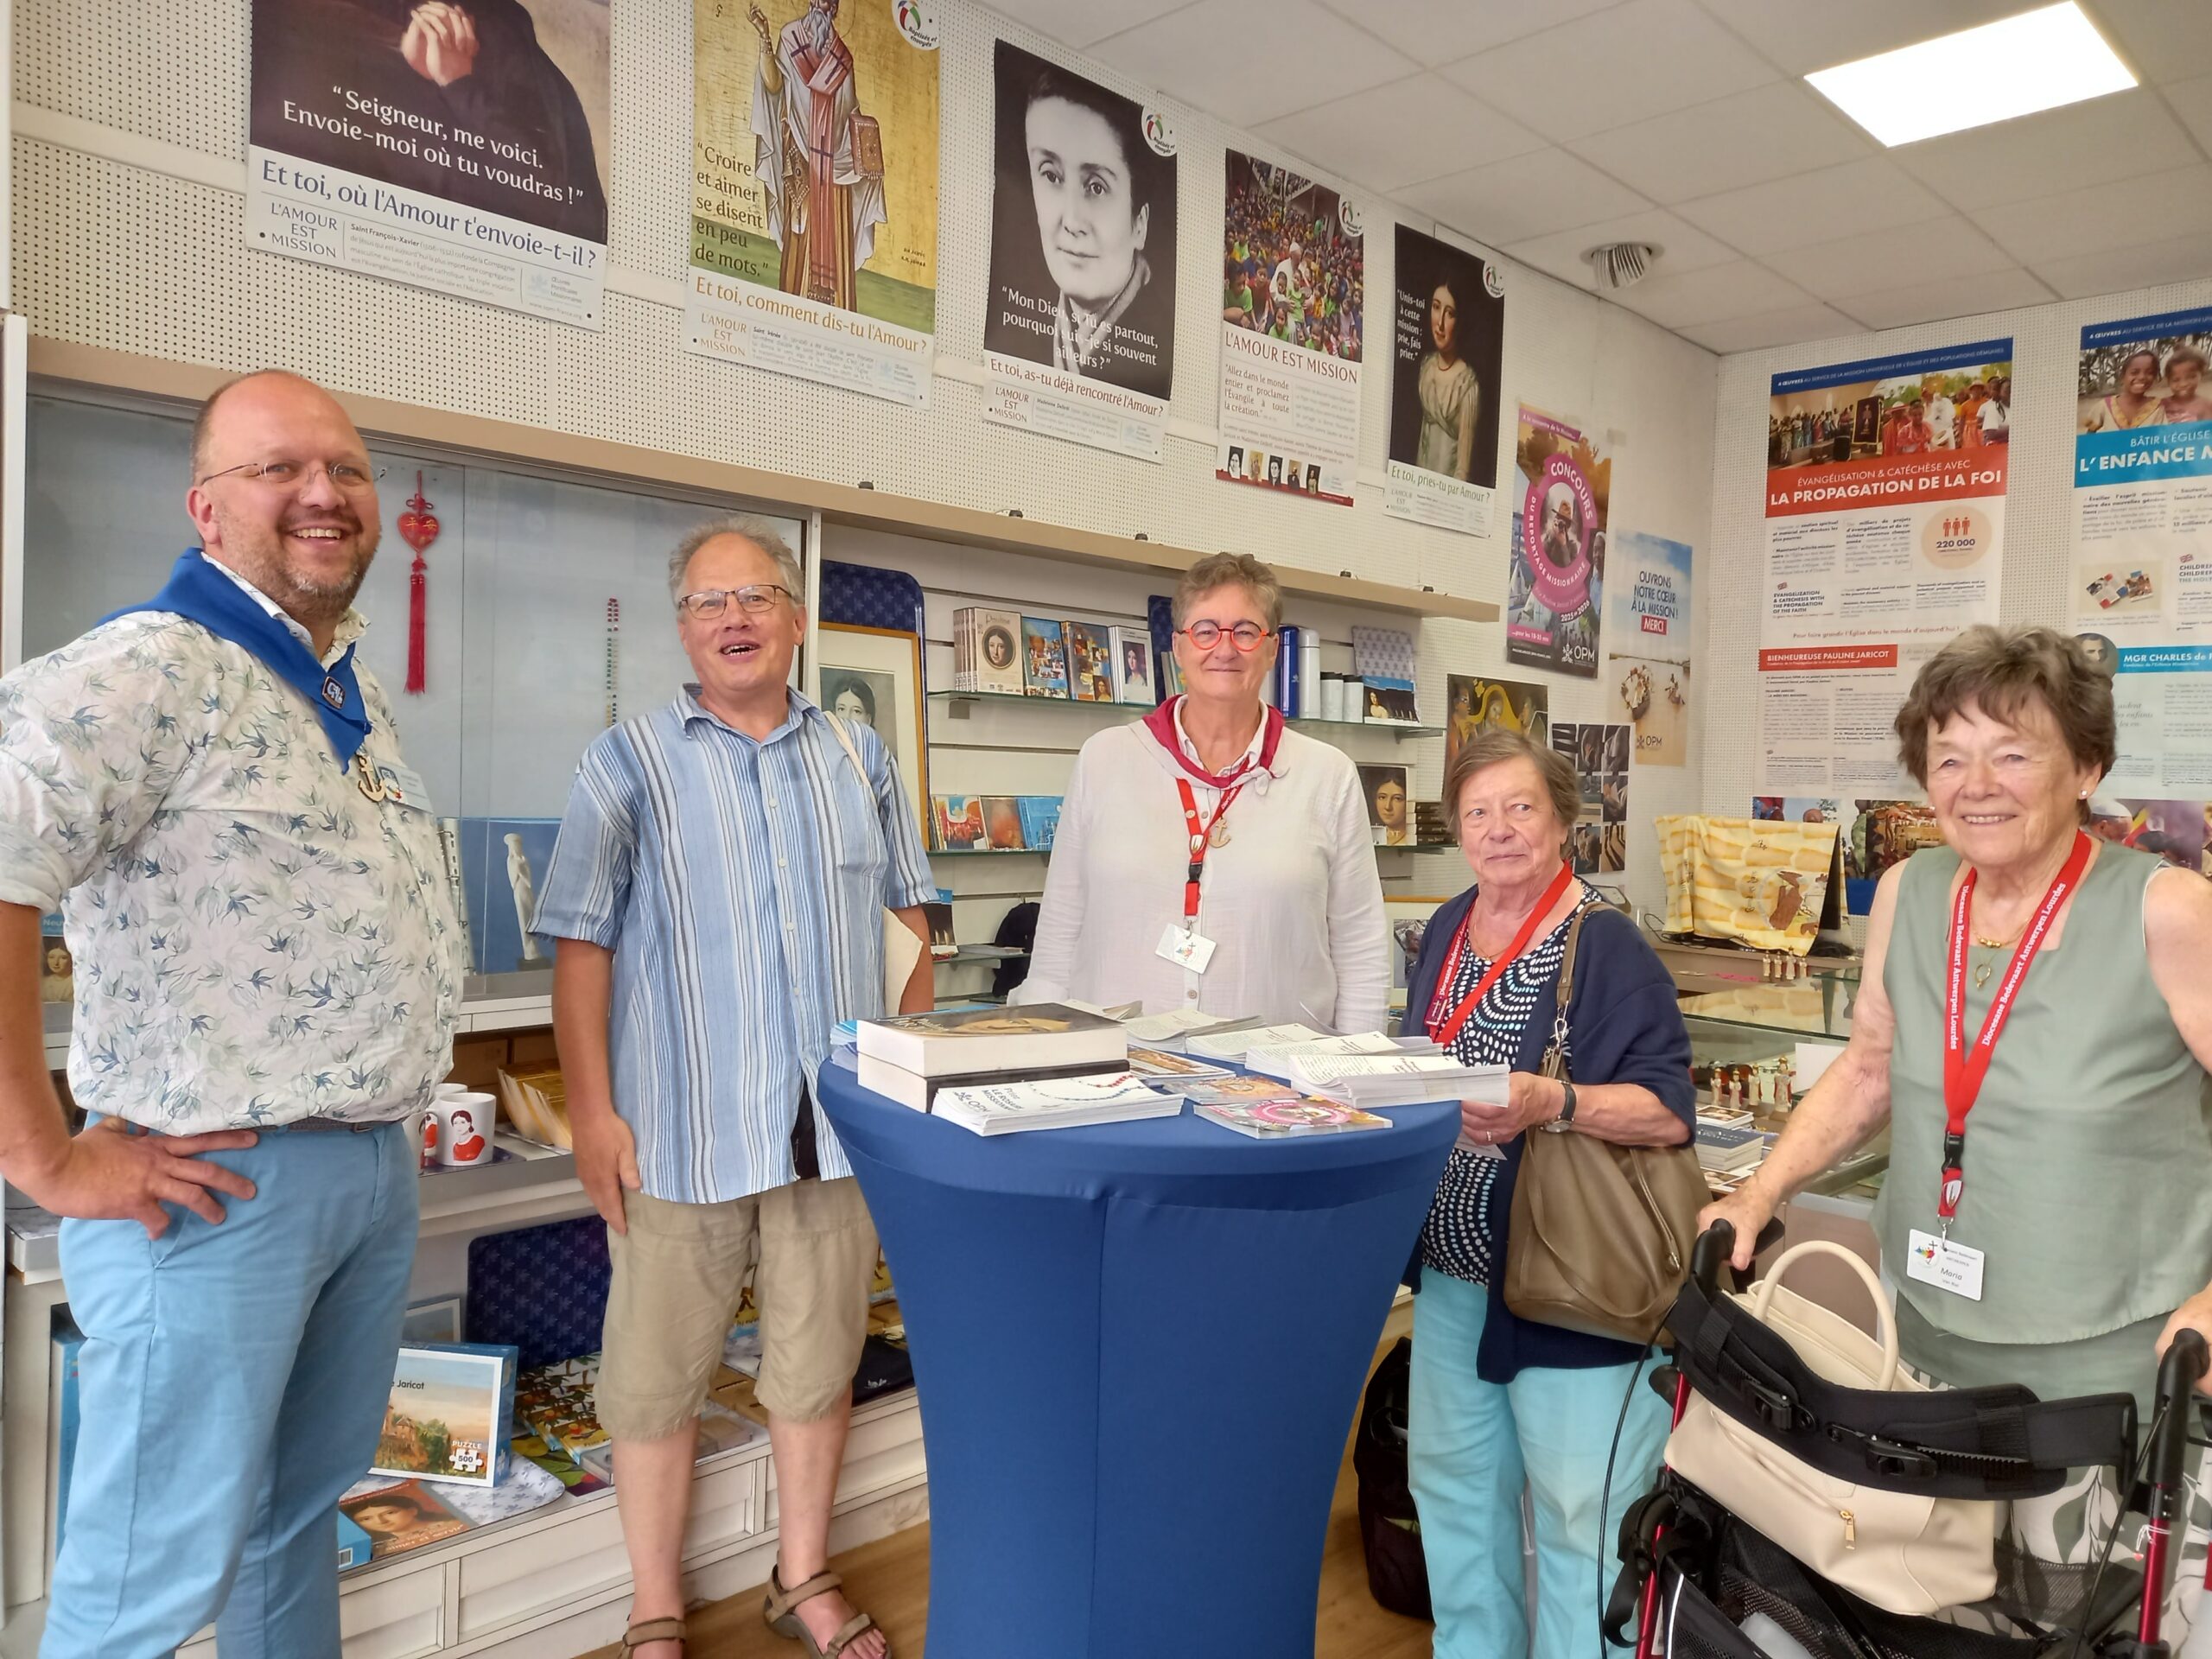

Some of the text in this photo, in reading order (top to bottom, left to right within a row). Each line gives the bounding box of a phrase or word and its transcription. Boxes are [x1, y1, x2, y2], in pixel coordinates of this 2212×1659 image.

[283, 100, 418, 157] Envoie-moi
[423, 147, 452, 168] où
[457, 156, 480, 176] tu
[485, 165, 563, 201] voudras
[454, 128, 485, 149] me
[490, 140, 543, 168] voici.
[696, 172, 759, 203] et aimer
[263, 159, 288, 185] Et
[295, 170, 331, 200] toi,
[338, 184, 368, 207] où
[374, 188, 460, 232] l'Amour
[464, 216, 585, 266] t'envoie-t-il
[271, 202, 338, 230] L'AMOUR
[696, 195, 764, 229] se disent
[291, 223, 317, 239] EST
[696, 221, 748, 249] en peu
[271, 233, 337, 258] MISSION
[695, 242, 715, 263] de
[696, 276, 712, 296] Et
[717, 284, 742, 306] toi,
[746, 295, 818, 325] comment
[822, 312, 864, 338] dis-tu
[868, 323, 918, 352] l'Amour
[701, 312, 747, 334] L'AMOUR
[1400, 304, 1421, 321] à cette
[1038, 298, 1069, 321] Dieu,
[1071, 311, 1081, 324] si
[1084, 313, 1097, 329] Tu
[1100, 321, 1112, 334] es
[1115, 324, 1159, 349] partout,
[1397, 318, 1420, 335] mission
[714, 328, 733, 341] EST
[1002, 310, 1157, 366] pourquoi suis-je si souvent
[1397, 333, 1421, 350] prie, fais
[2094, 330, 2122, 339] ŒUVRES
[700, 338, 746, 357] MISSION
[1056, 344, 1097, 368] ailleurs
[1225, 331, 1357, 385] L'AMOUR EST MISSION
[990, 358, 1003, 372] Et
[1005, 363, 1022, 379] toi,
[1024, 369, 1052, 386] as-tu
[1053, 375, 1074, 394] déjà
[1076, 384, 1122, 406] rencontré
[1123, 391, 1159, 416] l'Amour
[1243, 369, 1258, 382] dans
[1259, 372, 1265, 384] le
[1267, 375, 1288, 390] monde
[995, 386, 1029, 404] L'AMOUR
[1224, 377, 1289, 404] entier et proclamez
[1224, 386, 1289, 414] l'Évangile à toute
[994, 407, 1027, 423] MISSION
[1004, 399, 1018, 410] EST
[1224, 400, 1230, 410] la
[2130, 430, 2211, 448] BÂTIR L'ÉGLISE
[1391, 465, 1400, 479] Et
[1402, 469, 1415, 484] toi,
[1417, 474, 1446, 492] pries-tu
[1447, 484, 1459, 496] par
[1459, 486, 1485, 502] Amour
[1797, 460, 1971, 486] ÉVANGÉLISATION & CATÉCHÈSE AVEC
[1550, 461, 1593, 520] CONCOURS
[1770, 469, 2001, 505] LA PROPAGATION DE LA FOI
[1528, 496, 1586, 588] DU REPORTAGE MISSIONNAIRE
[1936, 538, 1976, 549] 220 000
[1639, 570, 1672, 589] OUVRONS
[1630, 597, 1637, 612] À
[1637, 601, 1647, 613] LA
[1633, 584, 1676, 605] NOTRE CŒUR
[1643, 617, 1664, 632] MERCI
[1573, 645, 1595, 663] OPM
[1767, 650, 1890, 662] BIENHEUREUSE PAULINE JARICOT
[2149, 653, 2192, 662] CHARLES
[2194, 652, 2207, 661] de
[1645, 735, 1662, 747] OPM
[1949, 885, 1970, 1051] Diocesane Bedevaart Antwerpen Lourdes
[1981, 881, 2066, 1046] Diocesane Bedevaart Antwerpen Lourdes
[1439, 966, 1453, 996] Diocesane
[397, 1380, 425, 1389] Jaricot
[452, 1440, 482, 1449] PUZZLE
